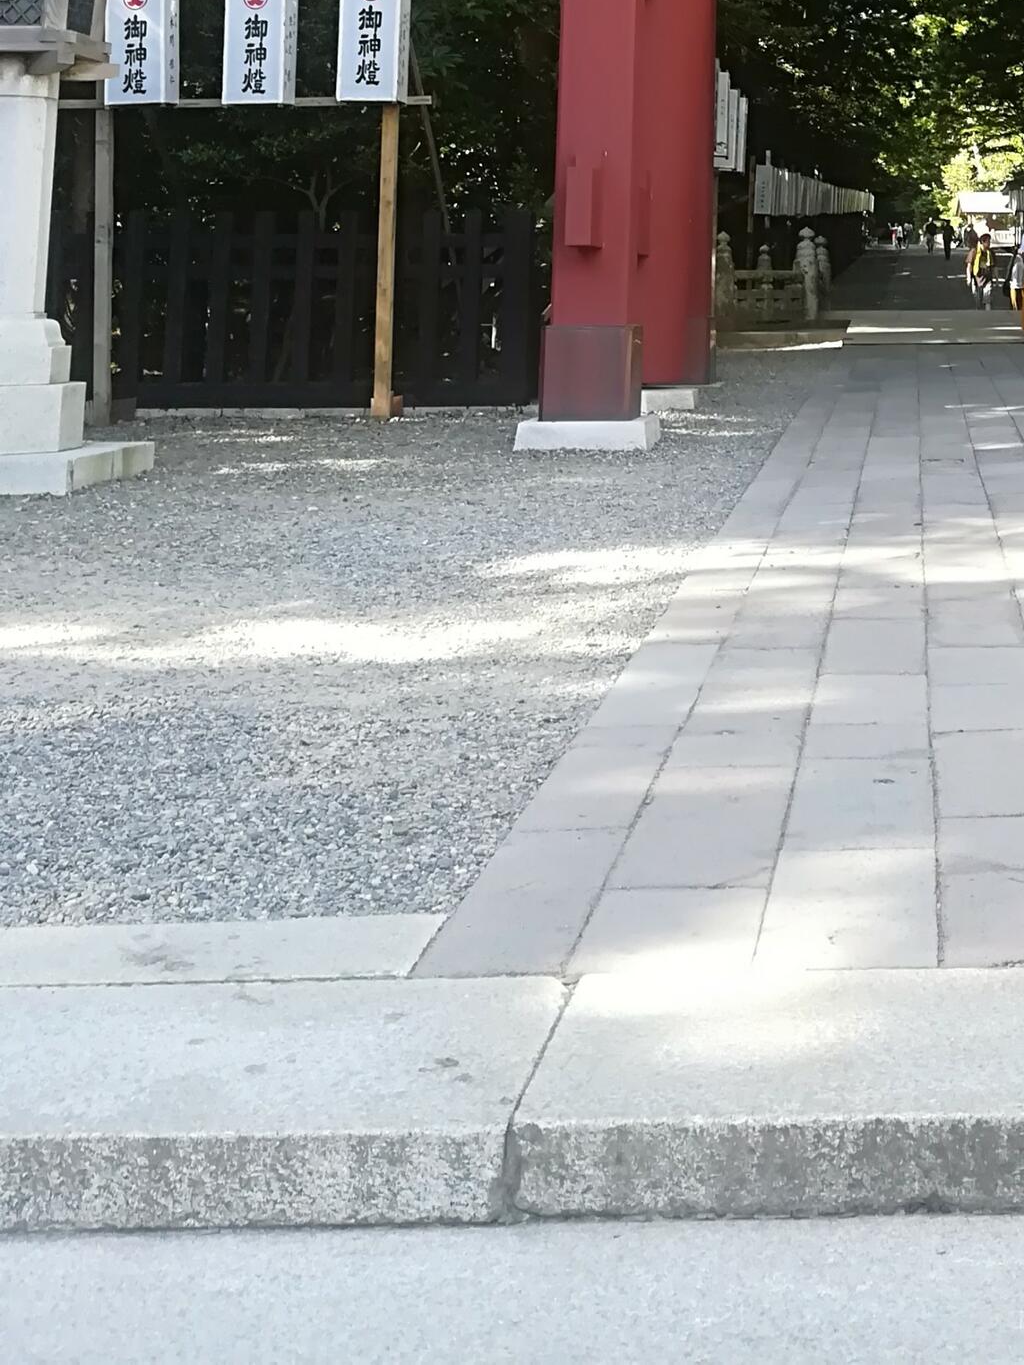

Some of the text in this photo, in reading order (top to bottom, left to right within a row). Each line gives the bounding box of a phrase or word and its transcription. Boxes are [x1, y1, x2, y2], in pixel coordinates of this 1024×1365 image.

[123, 15, 147, 94] 御神燈
[241, 14, 268, 94] 御神燈
[356, 5, 382, 85] 御神燈
